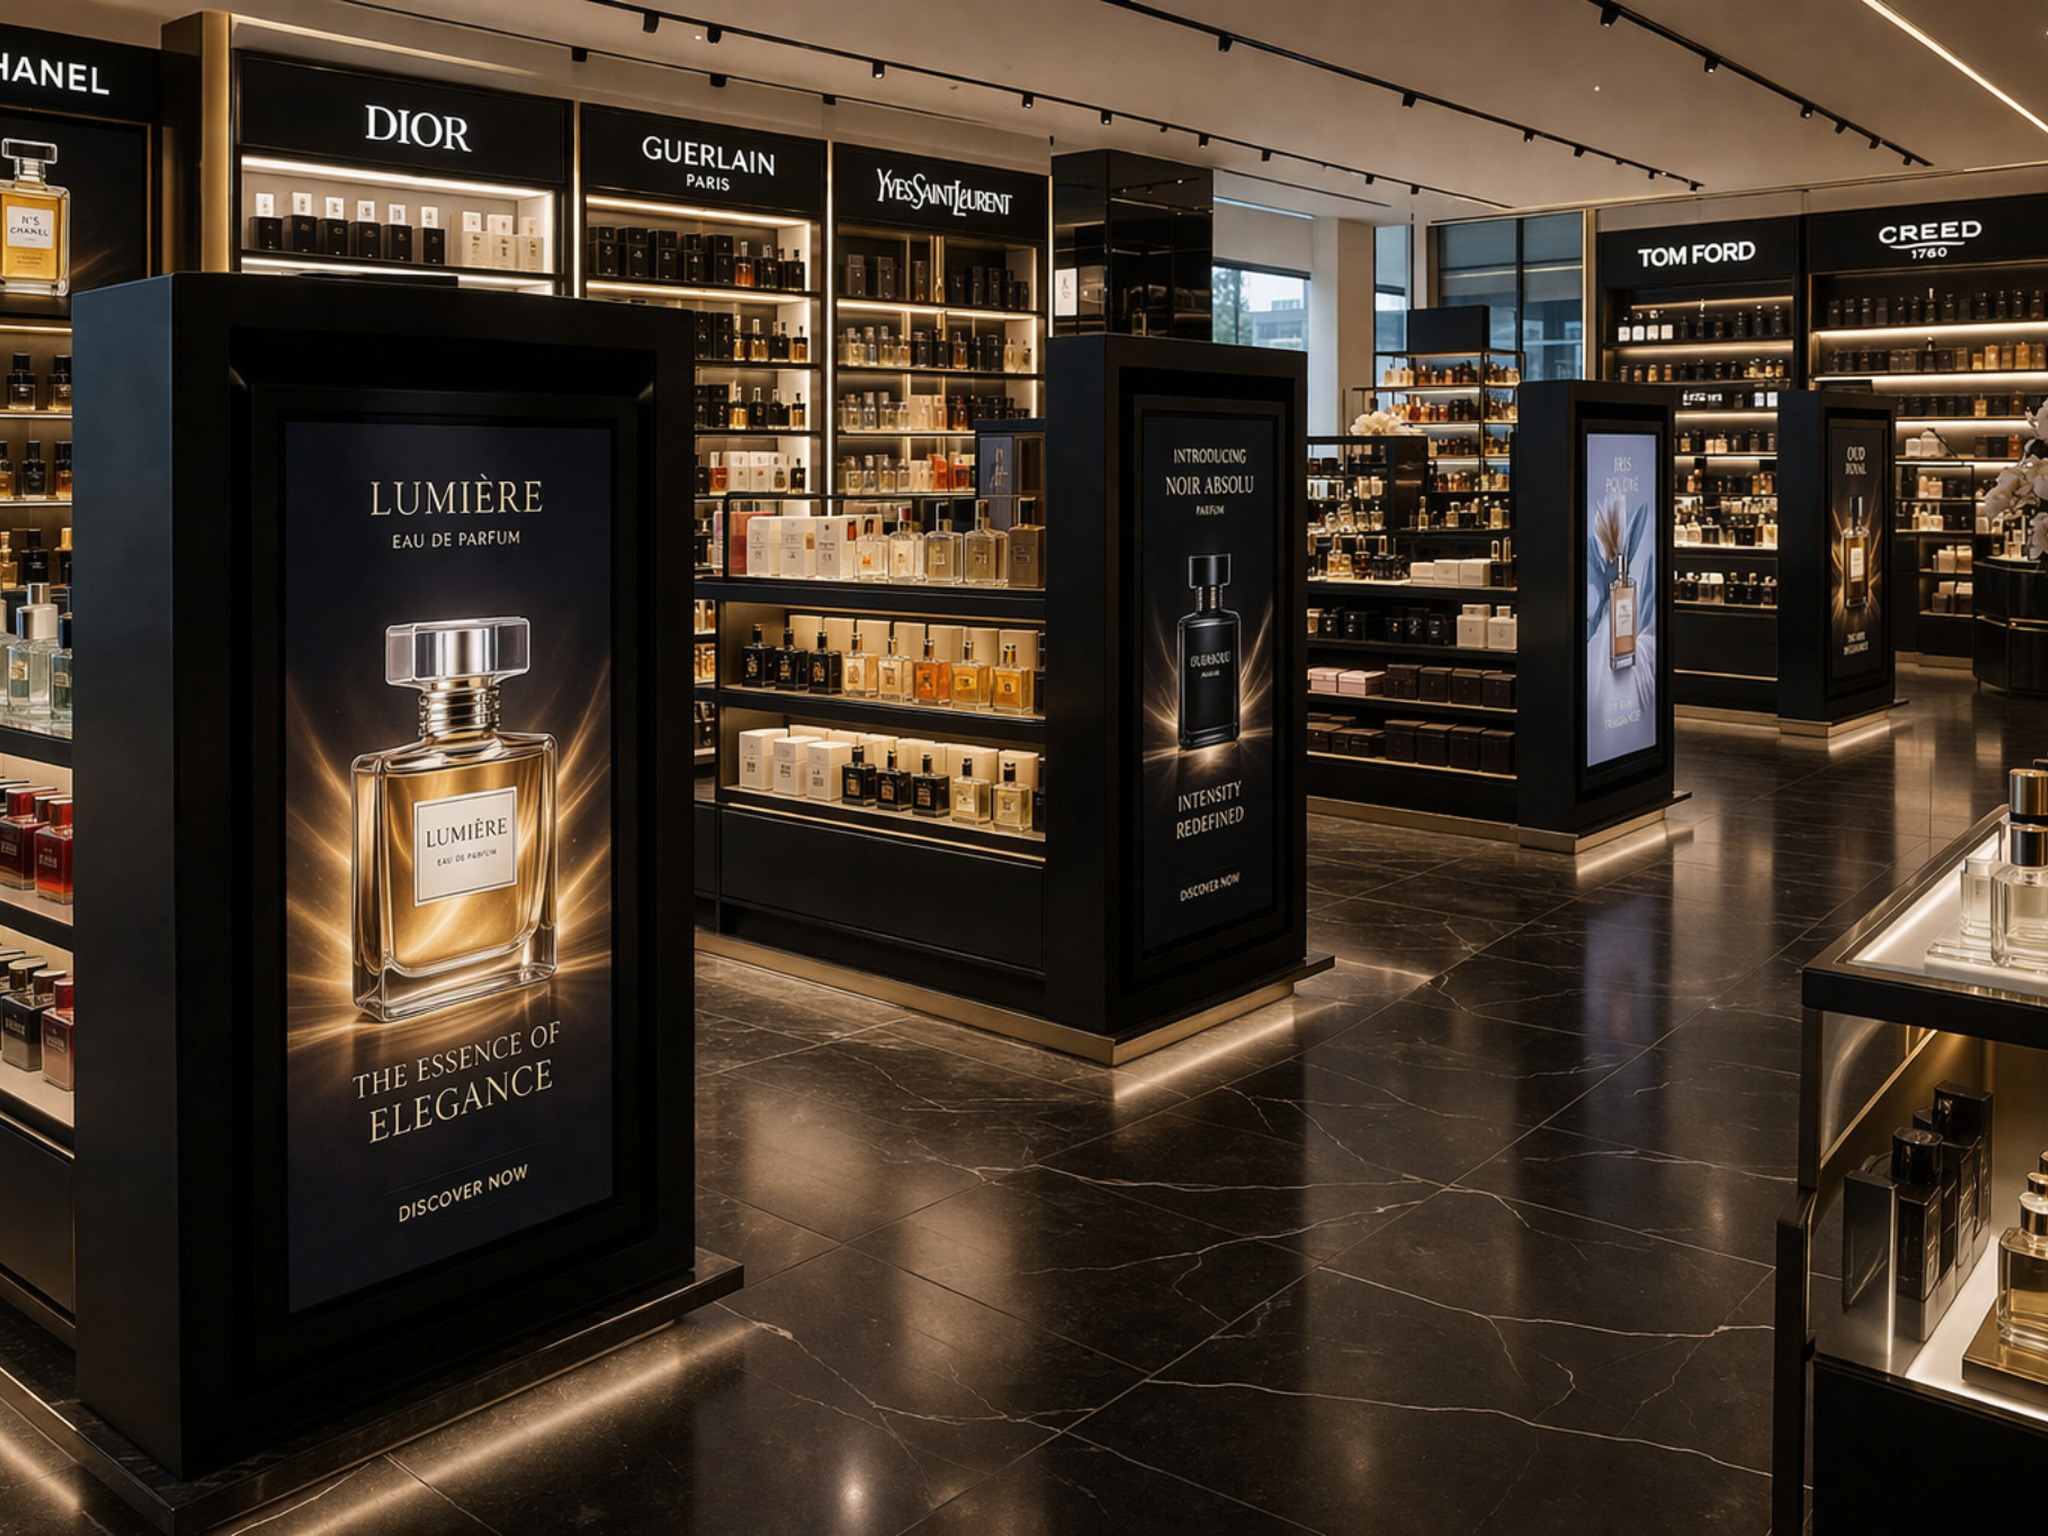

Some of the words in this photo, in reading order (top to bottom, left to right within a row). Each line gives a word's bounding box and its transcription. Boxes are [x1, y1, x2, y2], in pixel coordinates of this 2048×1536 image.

[364, 104, 473, 153] DIOR
[641, 135, 775, 176] GUERLAIN
[686, 173, 731, 191] PARIS
[1878, 220, 1983, 244] CREED
[1637, 245, 1688, 268] TOM
[1691, 240, 1756, 265] FORD
[1911, 246, 1948, 260] 1760
[1173, 448, 1247, 464] INTRODUCING
[370, 473, 544, 516] LUMIÈRE
[1165, 476, 1201, 496] NOIR
[1204, 475, 1255, 495] ABSOLU
[392, 533, 426, 550] EAU
[431, 531, 453, 548] DE
[458, 530, 521, 547] PARFUM
[1178, 780, 1242, 813] INTENSITY
[1176, 805, 1245, 840] REDEFINED
[436, 856, 454, 867] EAU
[455, 853, 465, 863] DE
[1220, 872, 1241, 888] NOW
[352, 1063, 408, 1100] THE
[416, 1031, 523, 1083] ESSENCE
[530, 1020, 561, 1049] OF
[369, 1058, 554, 1145] ELEGANCE
[398, 1180, 483, 1223] DISCOVER
[488, 1163, 529, 1191] NOW
